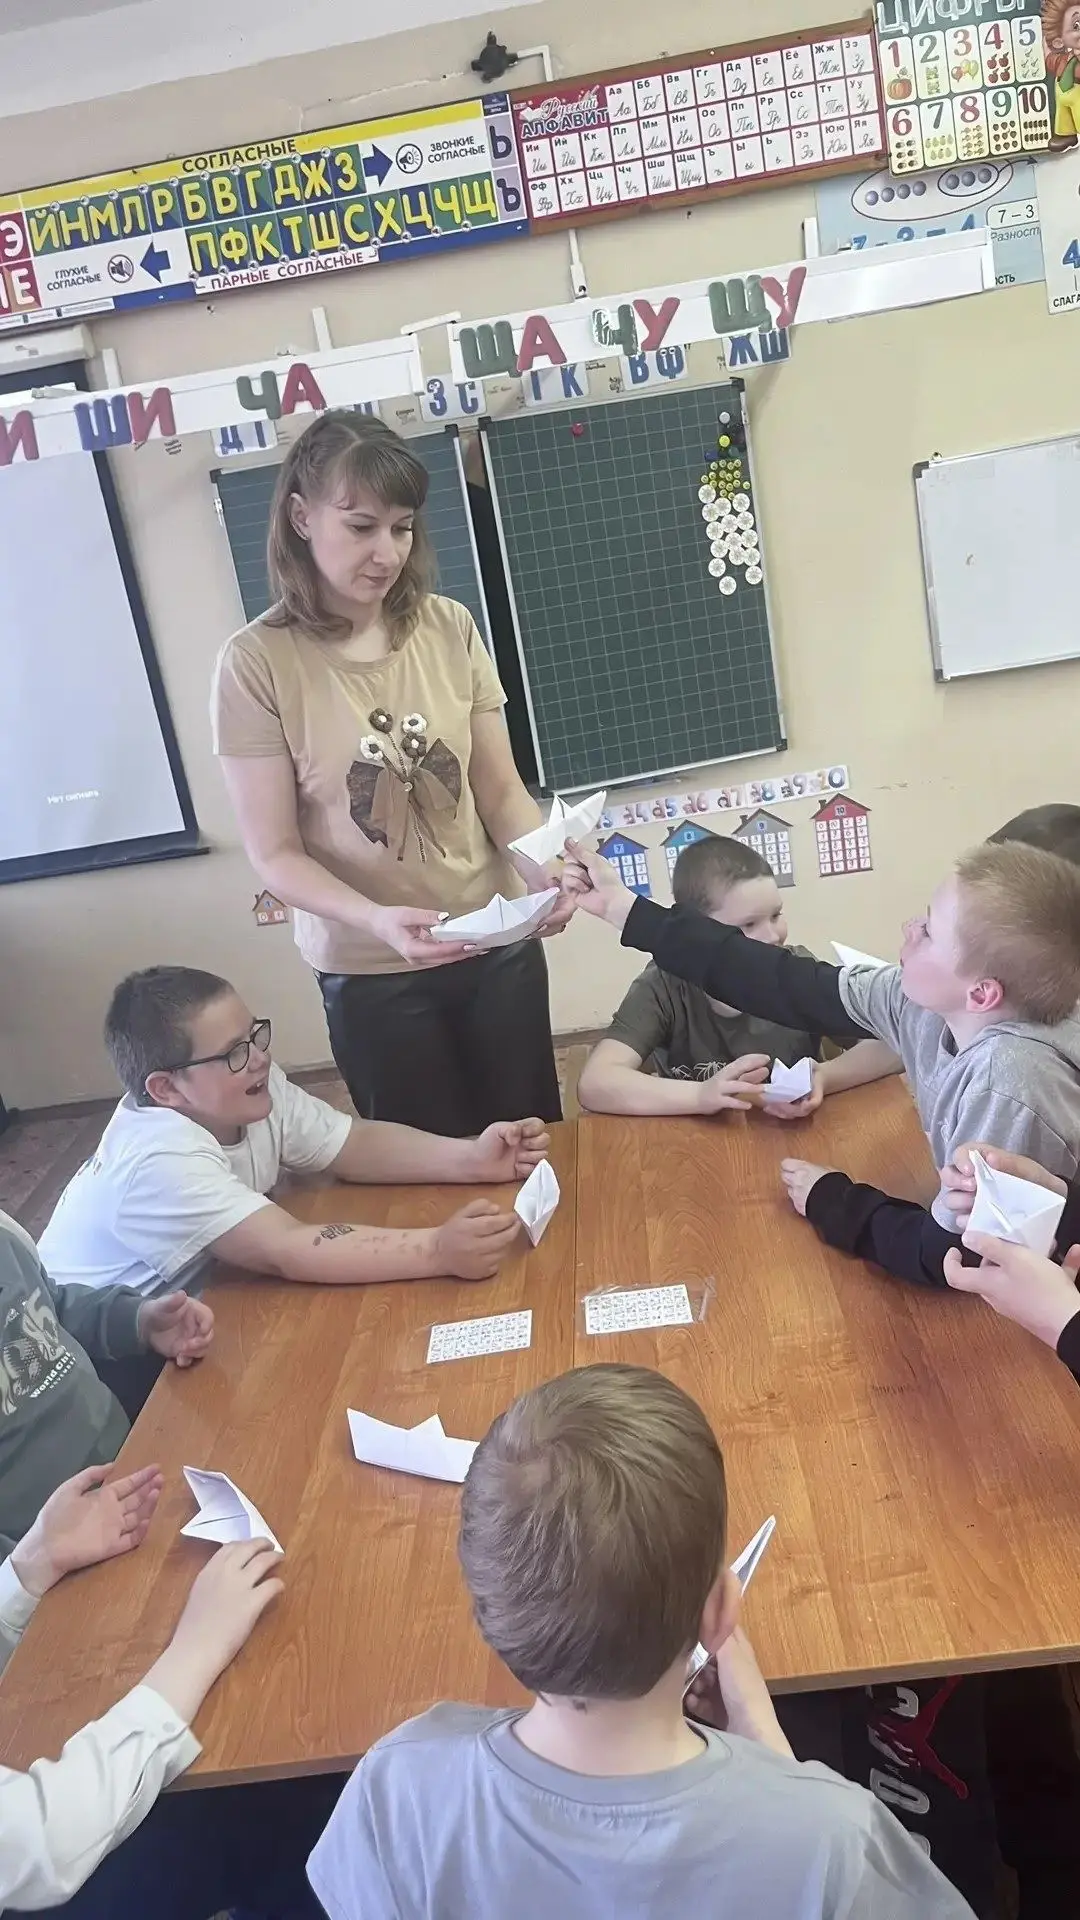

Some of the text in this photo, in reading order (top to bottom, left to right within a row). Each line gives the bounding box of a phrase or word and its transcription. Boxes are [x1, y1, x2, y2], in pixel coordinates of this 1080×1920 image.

[888, 19, 1036, 67] 1 2 3 4 5
[521, 108, 608, 138] АЛФАВИТ
[892, 86, 1047, 135] 6 7 8 9 10
[182, 139, 296, 173] СОГЛАСНЫЕ
[428, 145, 486, 164] СОГЛАСНЫЕ
[430, 136, 475, 152] ЗВОНКИЕ
[998, 209, 1006, 223] 7
[1025, 204, 1034, 219] 3
[0, 220, 24, 257] Э
[991, 226, 1040, 241] Разност
[47, 273, 102, 291] СОГЛАСНЫЕ
[55, 265, 89, 280] ГЛУХИЕ
[211, 252, 364, 290] ПАРНЫЕ СОГЛАСНЫЕ
[459, 266, 808, 378] ЩА ЧУ ЩУ
[73, 388, 176, 451] ШИ
[236, 363, 327, 420] ЧА
[29, 1369, 58, 1398] World
